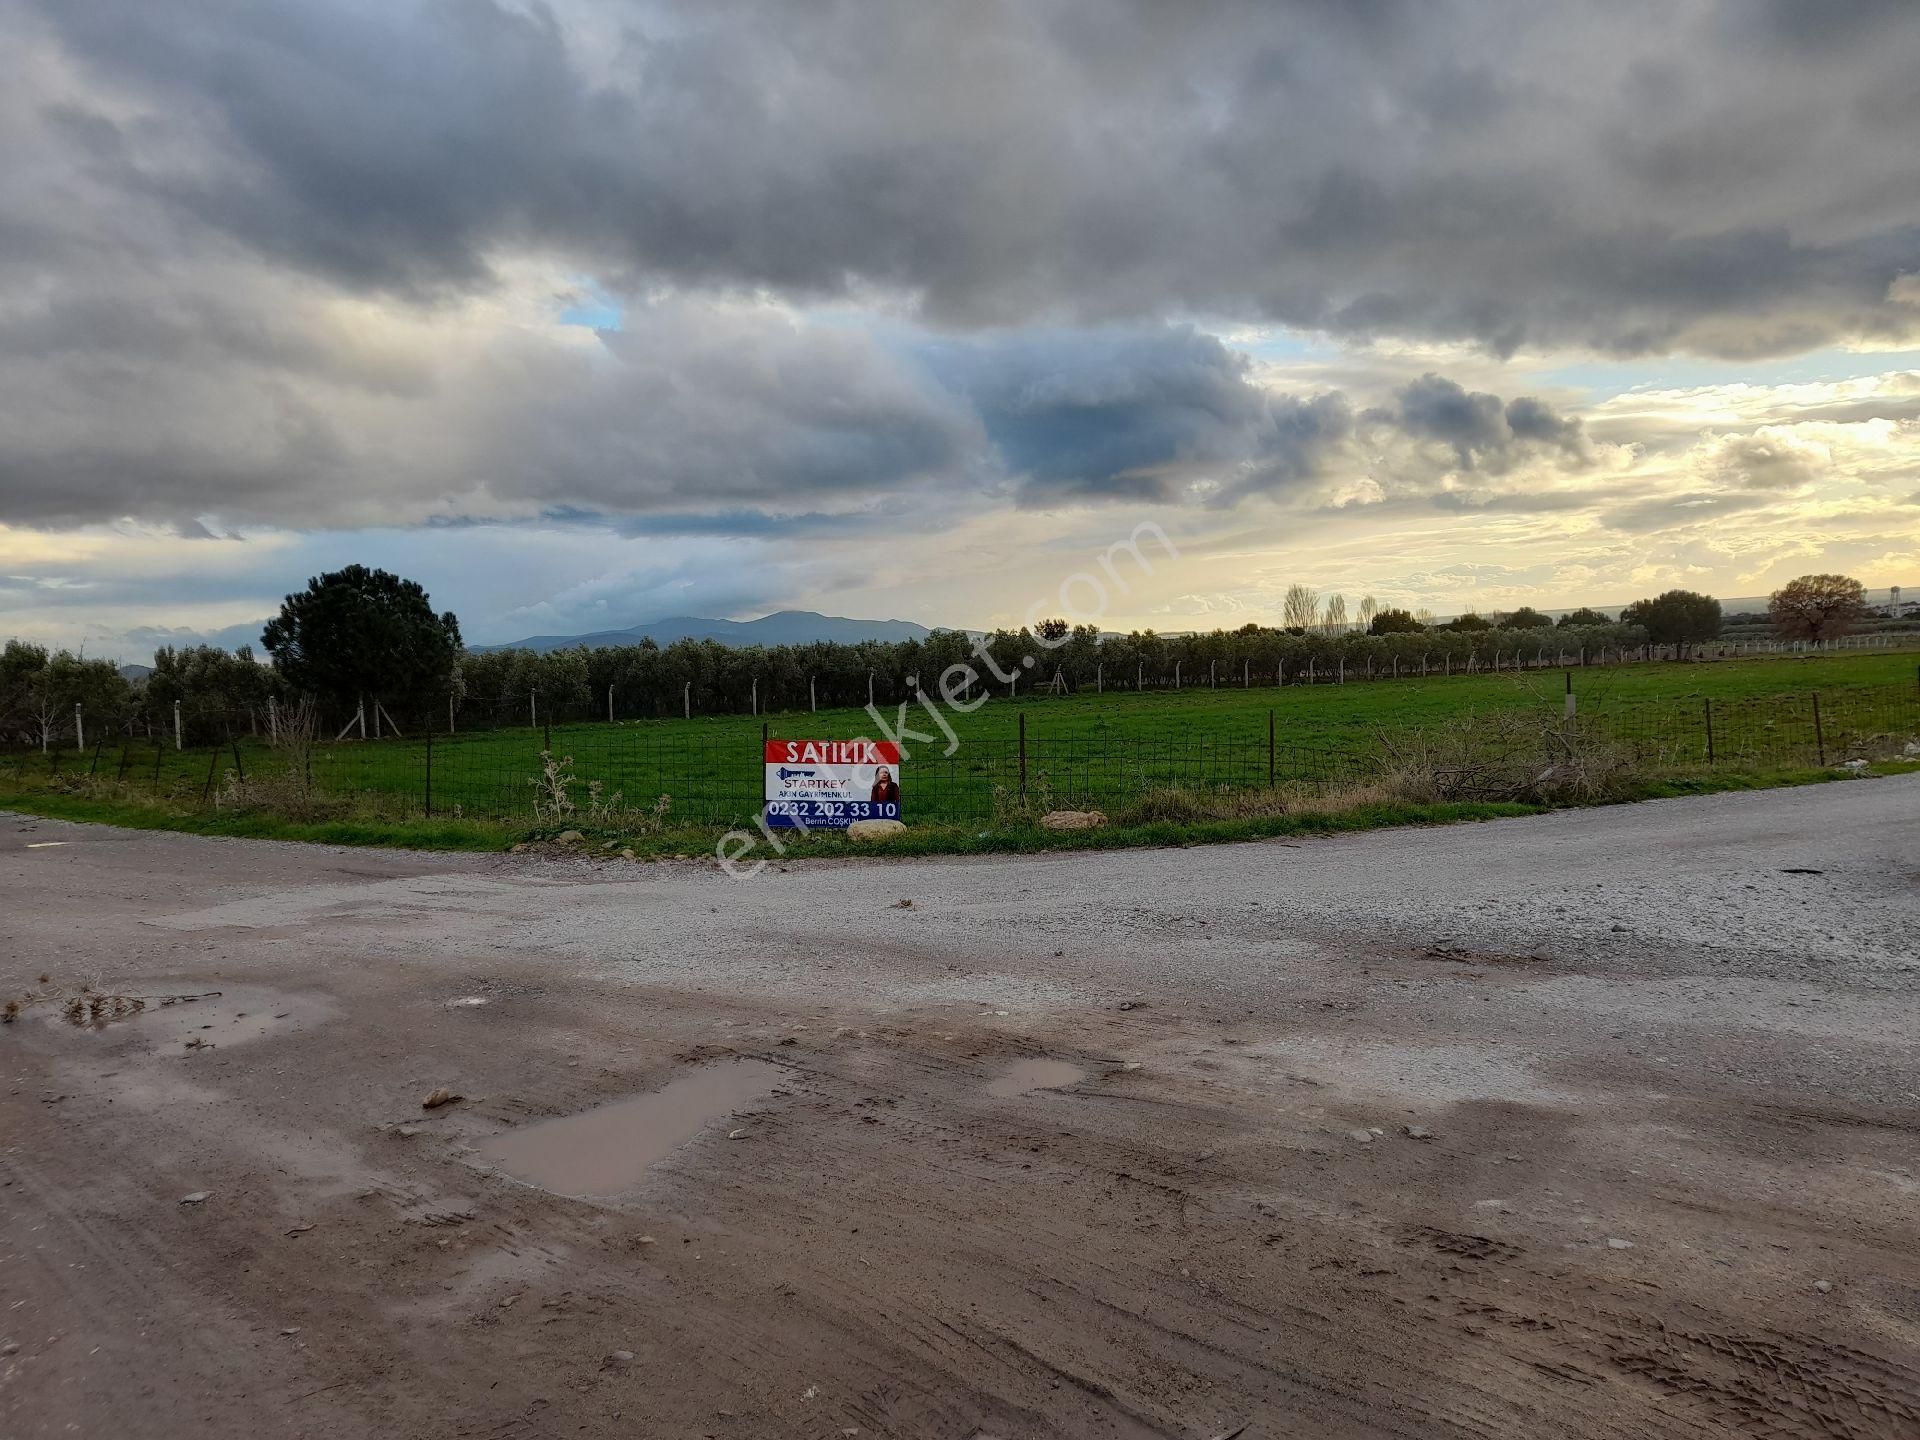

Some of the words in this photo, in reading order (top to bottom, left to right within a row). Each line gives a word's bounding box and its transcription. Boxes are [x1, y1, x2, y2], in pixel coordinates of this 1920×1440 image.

[786, 741, 877, 763] SATILIK
[784, 779, 846, 789] STARTKEY
[768, 801, 809, 816] 0232
[814, 802, 844, 816] 202
[850, 803, 870, 816] 33
[877, 803, 896, 817] 10
[805, 817, 826, 825] Berrin
